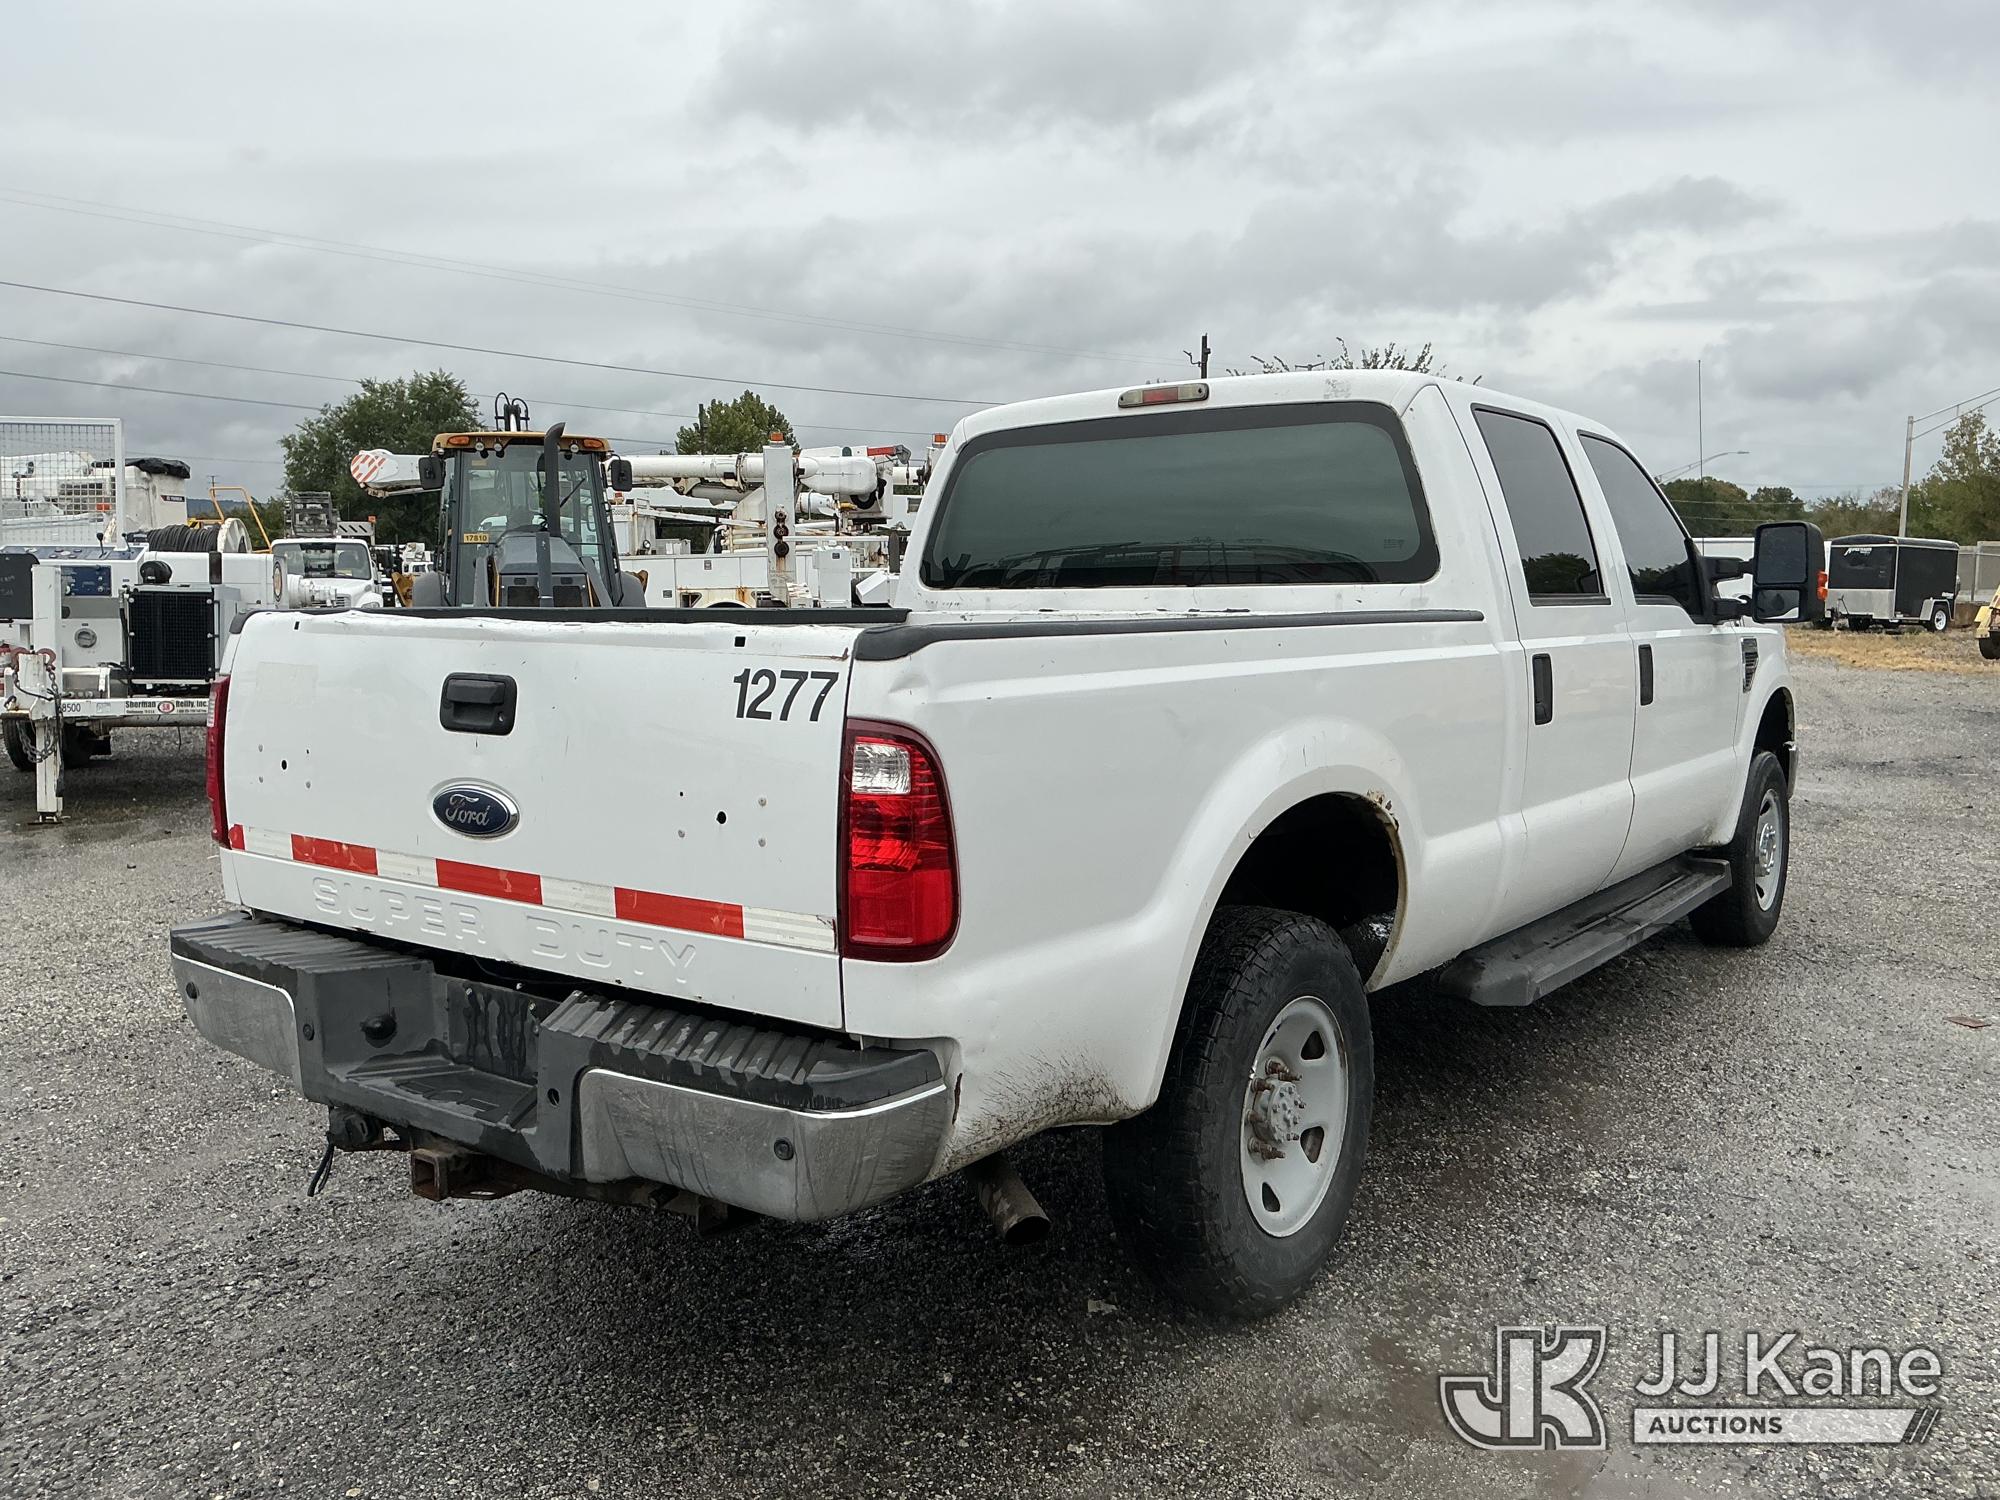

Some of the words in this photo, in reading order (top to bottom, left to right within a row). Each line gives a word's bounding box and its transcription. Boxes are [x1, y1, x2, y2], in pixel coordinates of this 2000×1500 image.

[733, 668, 840, 722] 1277
[444, 793, 491, 827] Ford
[312, 876, 487, 945] SUPER
[525, 915, 697, 985] DUTY
